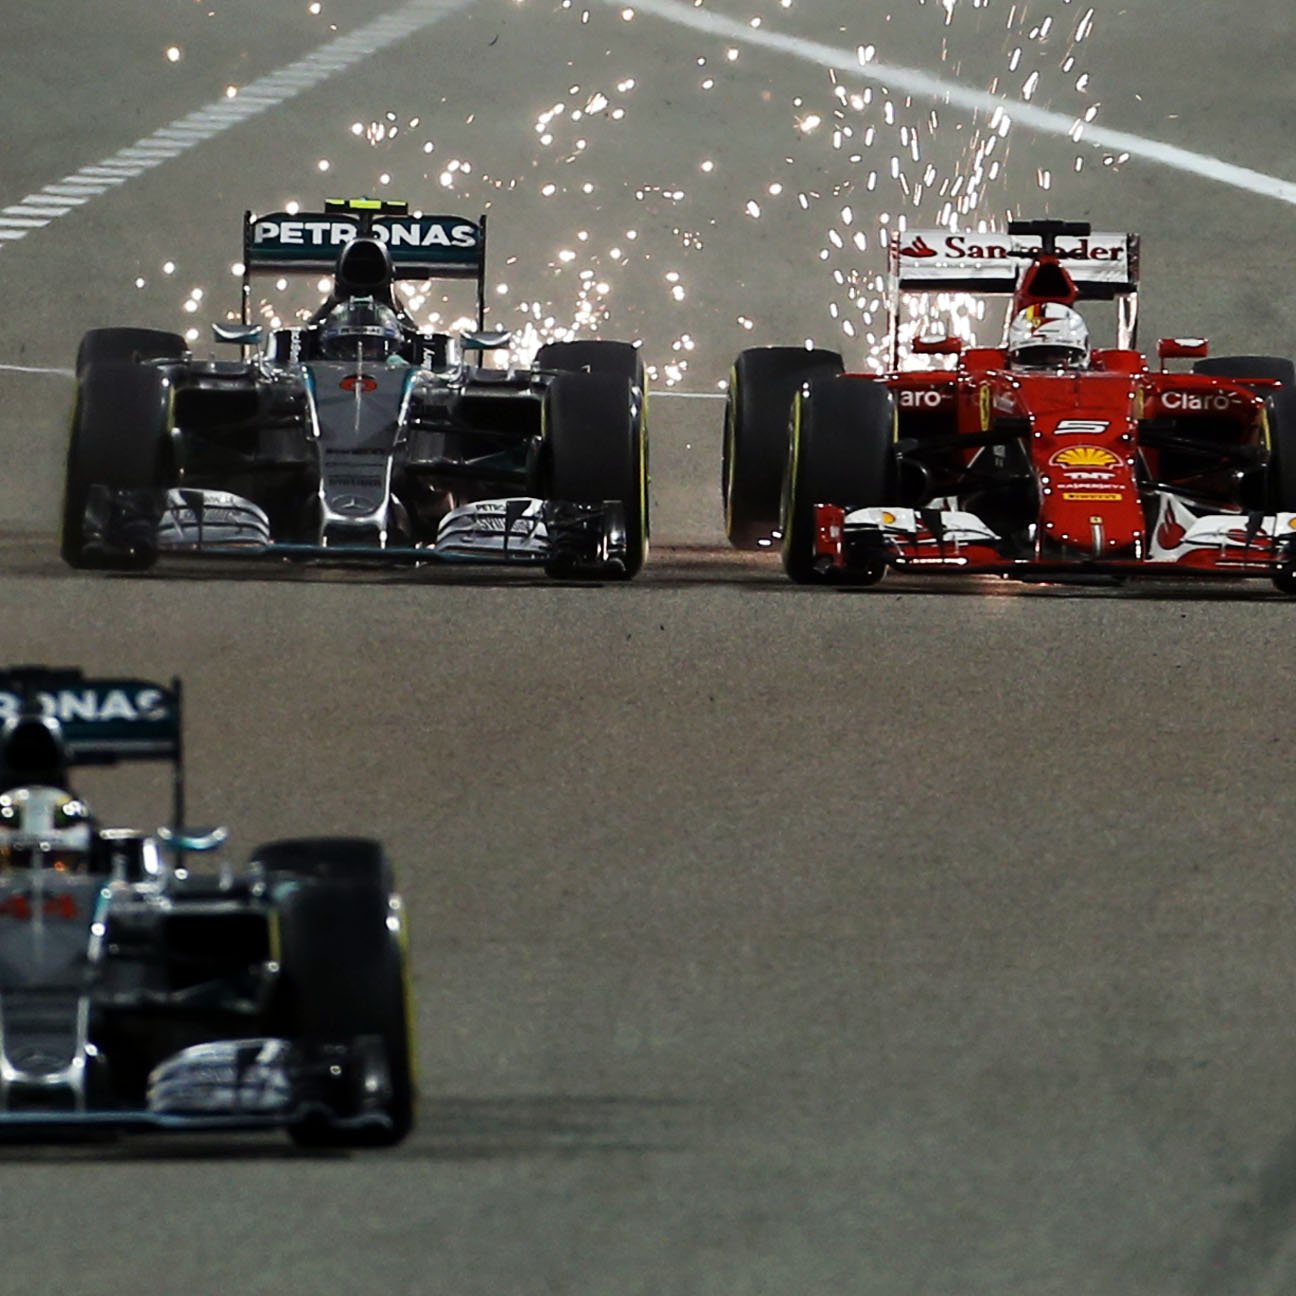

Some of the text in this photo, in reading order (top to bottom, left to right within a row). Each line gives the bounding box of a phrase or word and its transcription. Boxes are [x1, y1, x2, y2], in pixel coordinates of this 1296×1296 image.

[944, 236, 1125, 262] Sander
[900, 390, 942, 407] aro
[1161, 391, 1230, 410] Claro
[1053, 420, 1110, 435] 5
